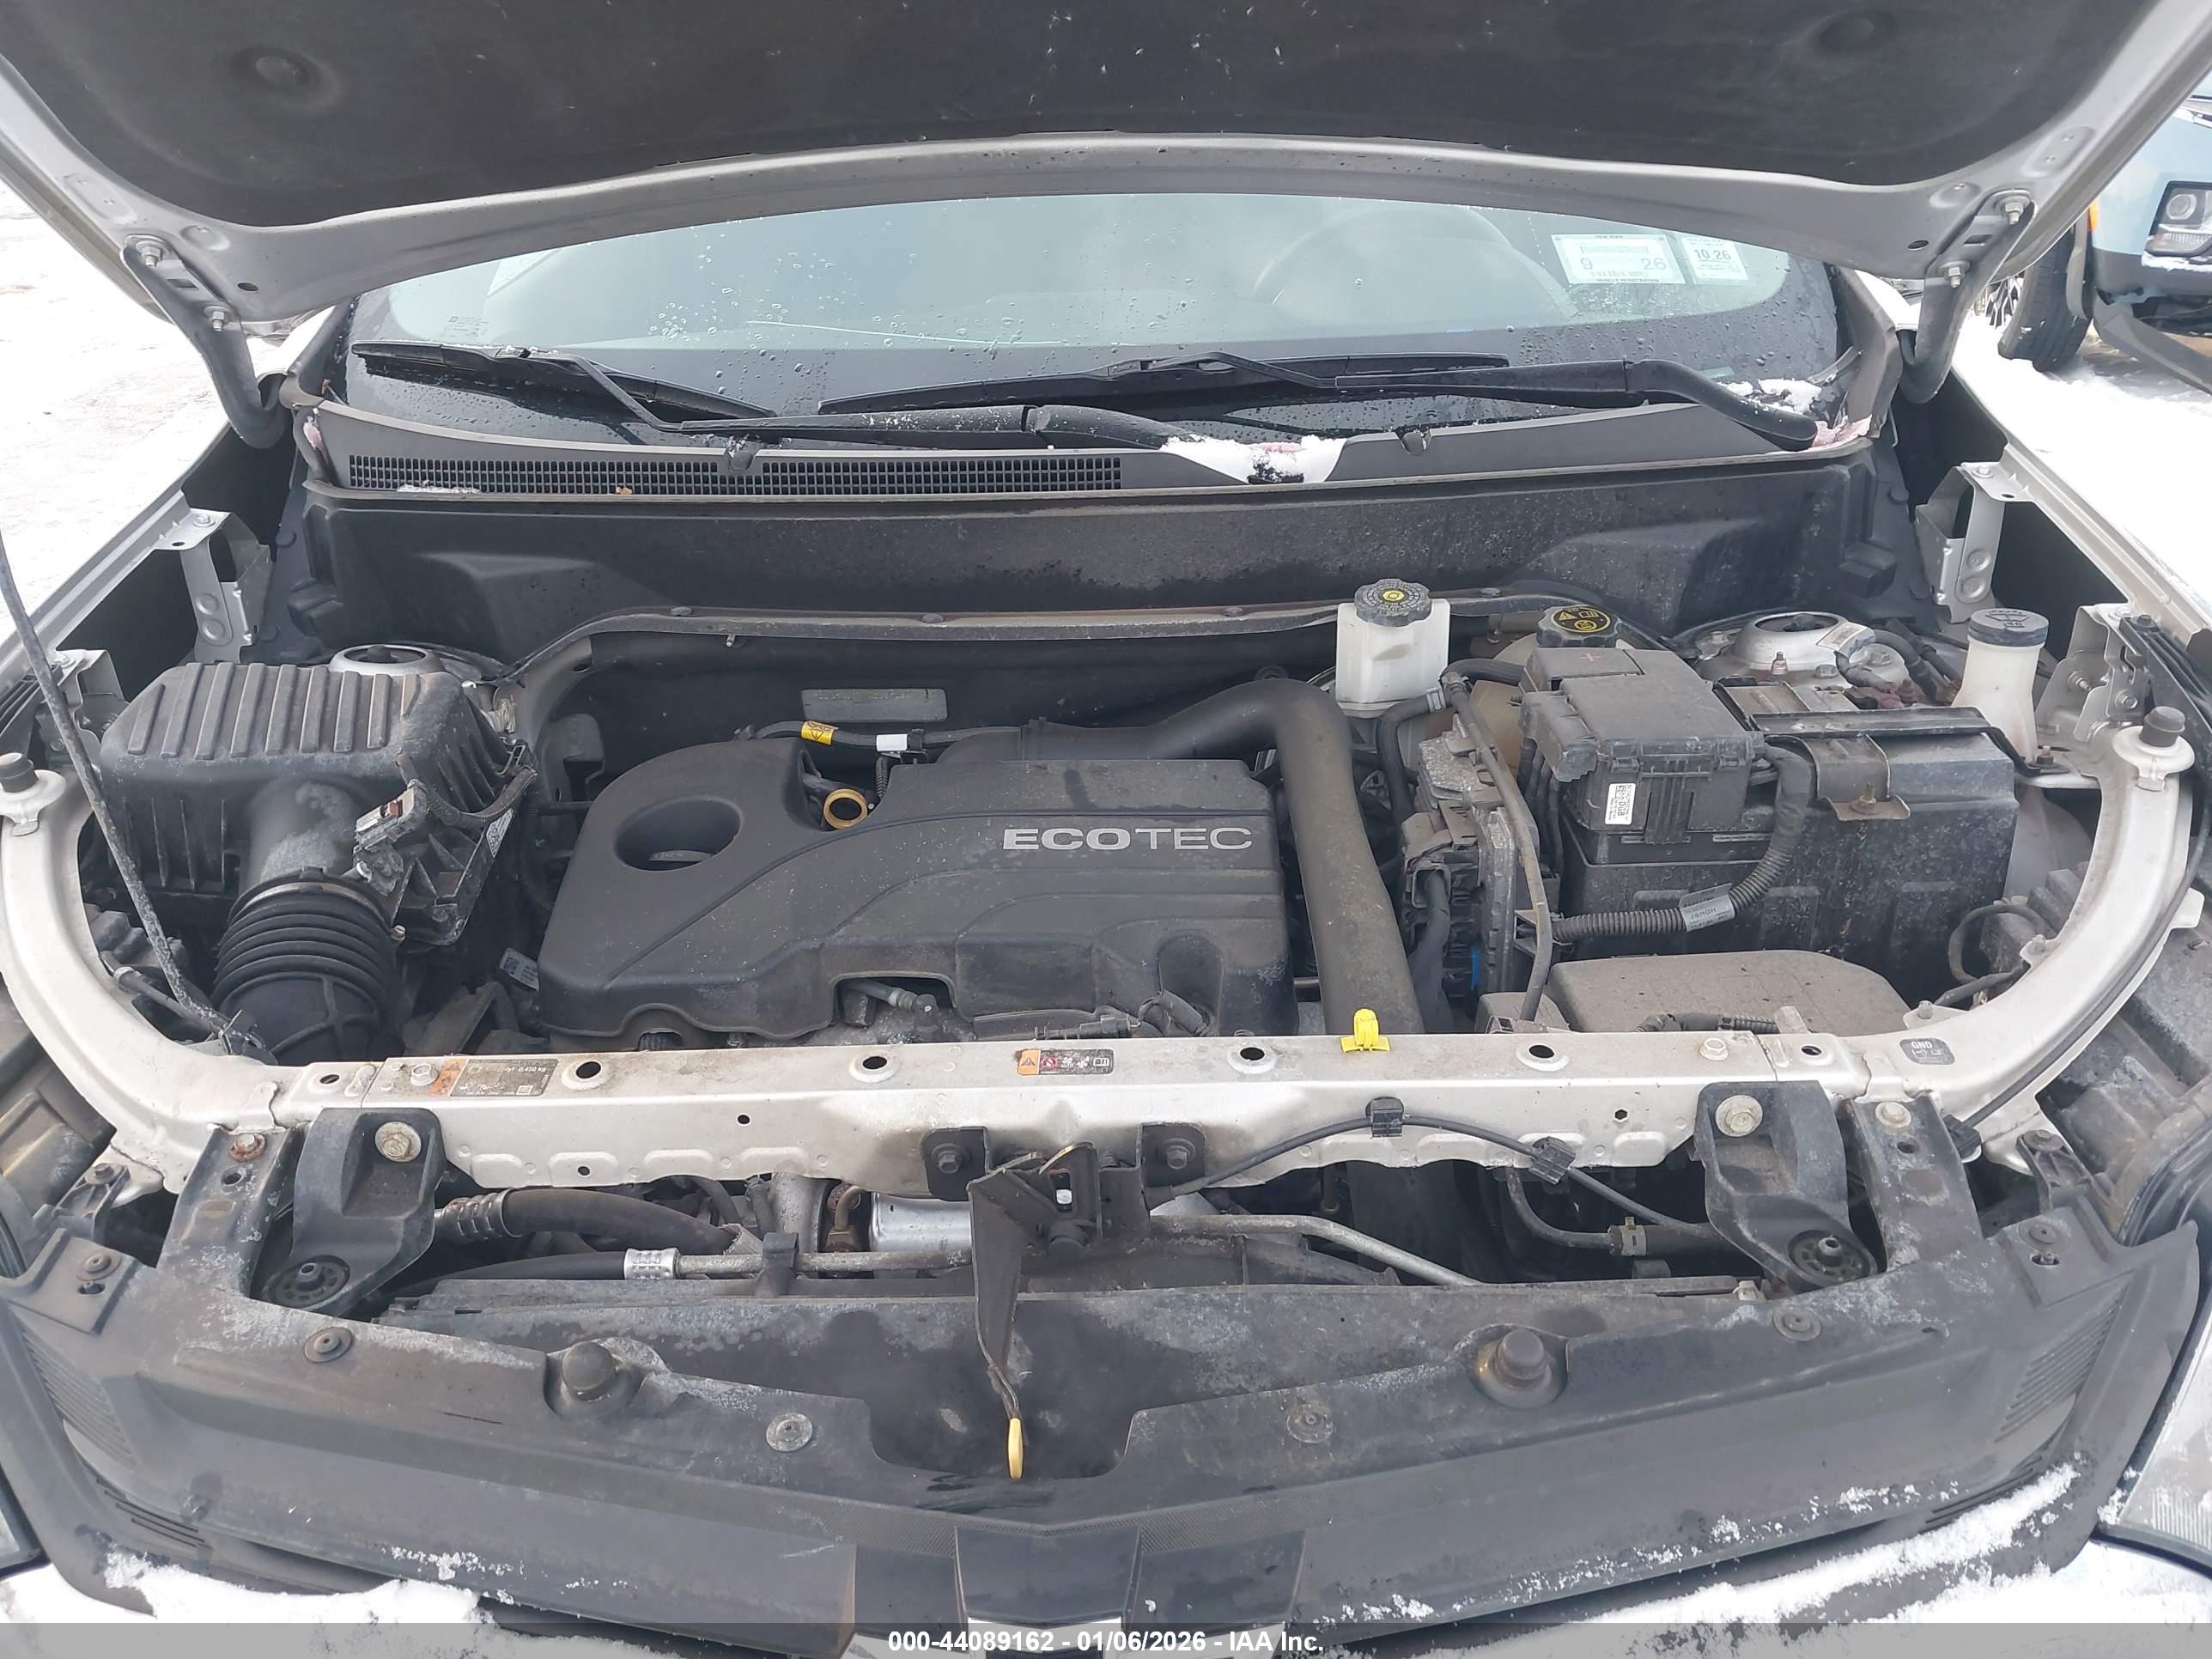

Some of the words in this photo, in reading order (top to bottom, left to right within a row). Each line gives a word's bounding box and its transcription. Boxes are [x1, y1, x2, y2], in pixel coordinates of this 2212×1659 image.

[1580, 258, 1594, 270] 9
[1641, 258, 1667, 270] 26
[1002, 827, 1253, 850] ECOTEC
[1911, 1041, 1933, 1049] GND
